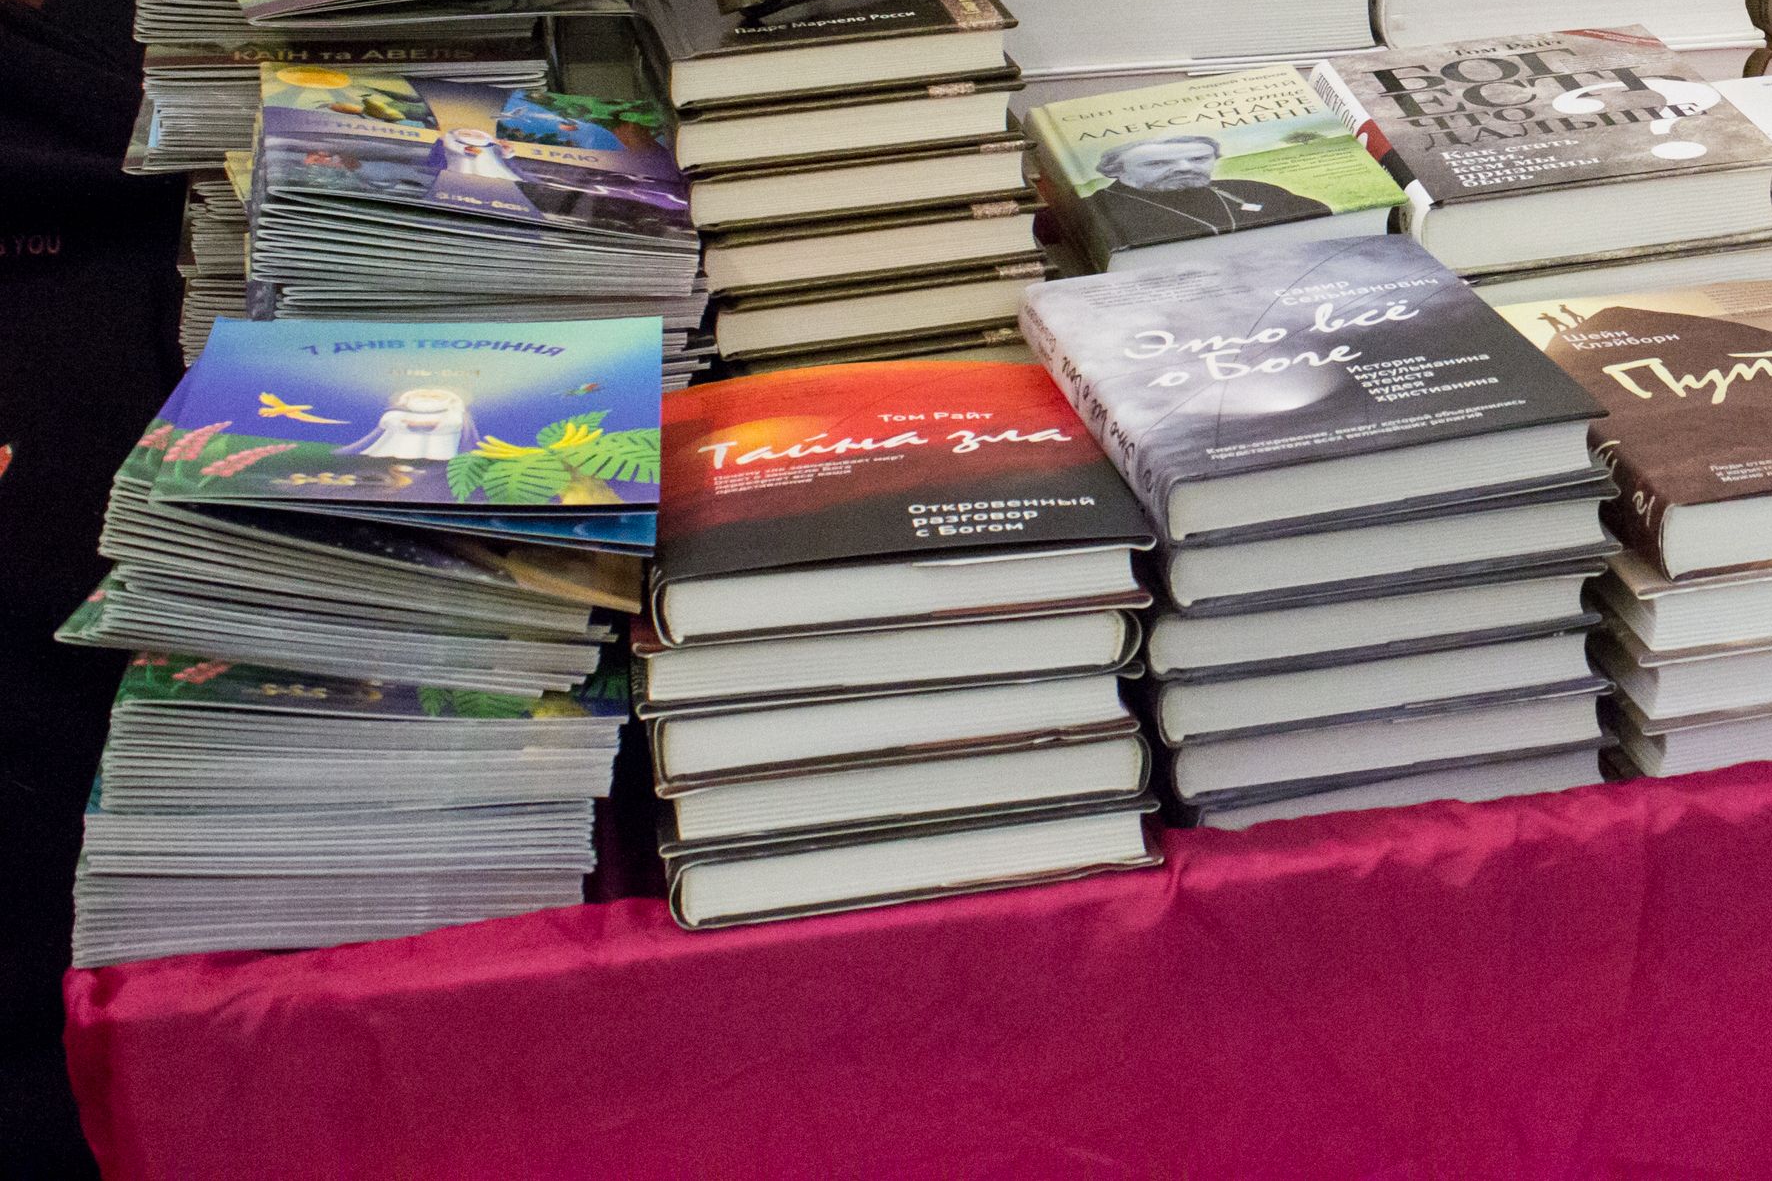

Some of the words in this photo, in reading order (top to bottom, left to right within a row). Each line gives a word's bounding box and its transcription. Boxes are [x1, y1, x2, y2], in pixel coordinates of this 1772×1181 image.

[791, 14, 867, 29] Марчело
[869, 10, 916, 20] Росси
[1362, 47, 1579, 95] БОГ
[1219, 105, 1321, 130] МЕНЕ
[1408, 105, 1537, 131] ЧТО
[1423, 101, 1708, 151] ДАЛЬШЕ
[1440, 147, 1498, 160] Как
[14, 234, 63, 256] YOU
[1123, 326, 1289, 361] Это
[1309, 299, 1420, 333] всё
[1561, 328, 1630, 345] Шейн
[414, 338, 566, 357] ТВОРІННЯ
[1571, 331, 1681, 352] Клэйборн
[1147, 368, 1189, 388] о
[1200, 342, 1363, 382] Боге
[1346, 355, 1427, 374] История
[1354, 353, 1491, 381] мусульманина
[1374, 376, 1499, 403] христианина
[877, 411, 926, 423] Том
[932, 409, 994, 421] Райт
[697, 431, 930, 470] Тайна
[946, 424, 1073, 455] зла
[907, 495, 1096, 516] Откровенный
[911, 507, 1040, 528] разговор
[915, 526, 931, 537] с
[938, 519, 1025, 537] Богом
